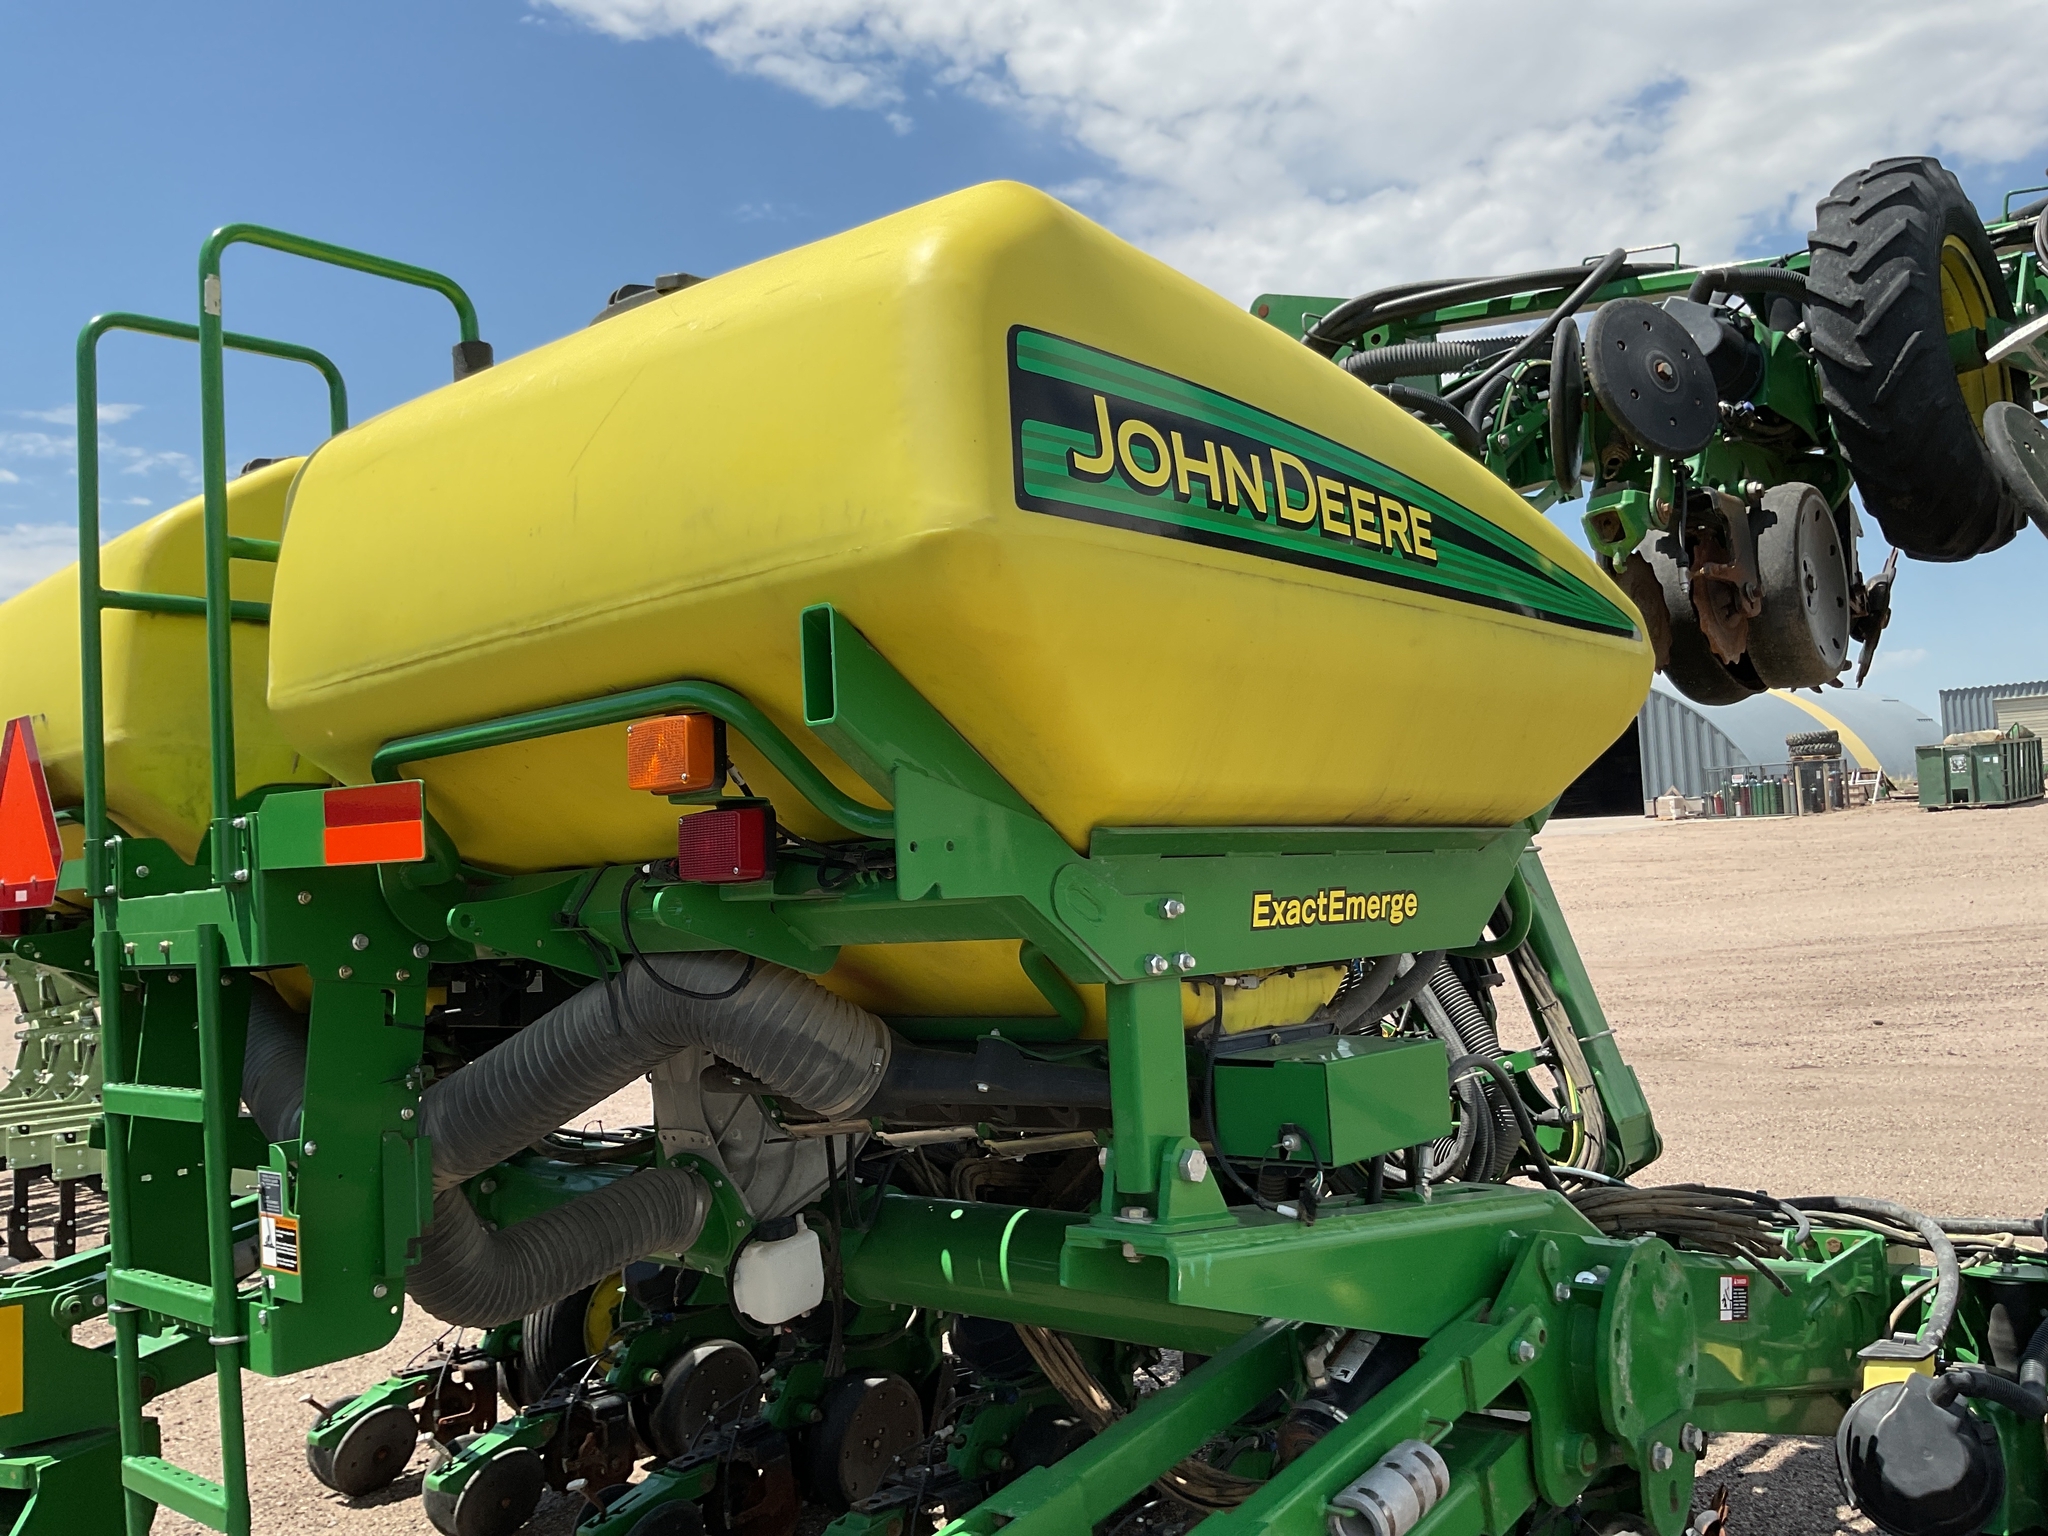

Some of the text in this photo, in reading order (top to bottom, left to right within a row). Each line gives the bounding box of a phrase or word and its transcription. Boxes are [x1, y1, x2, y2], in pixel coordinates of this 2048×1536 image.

[1072, 394, 1438, 562] JOHN DEERE
[1251, 889, 1418, 928] ExactEmerge
